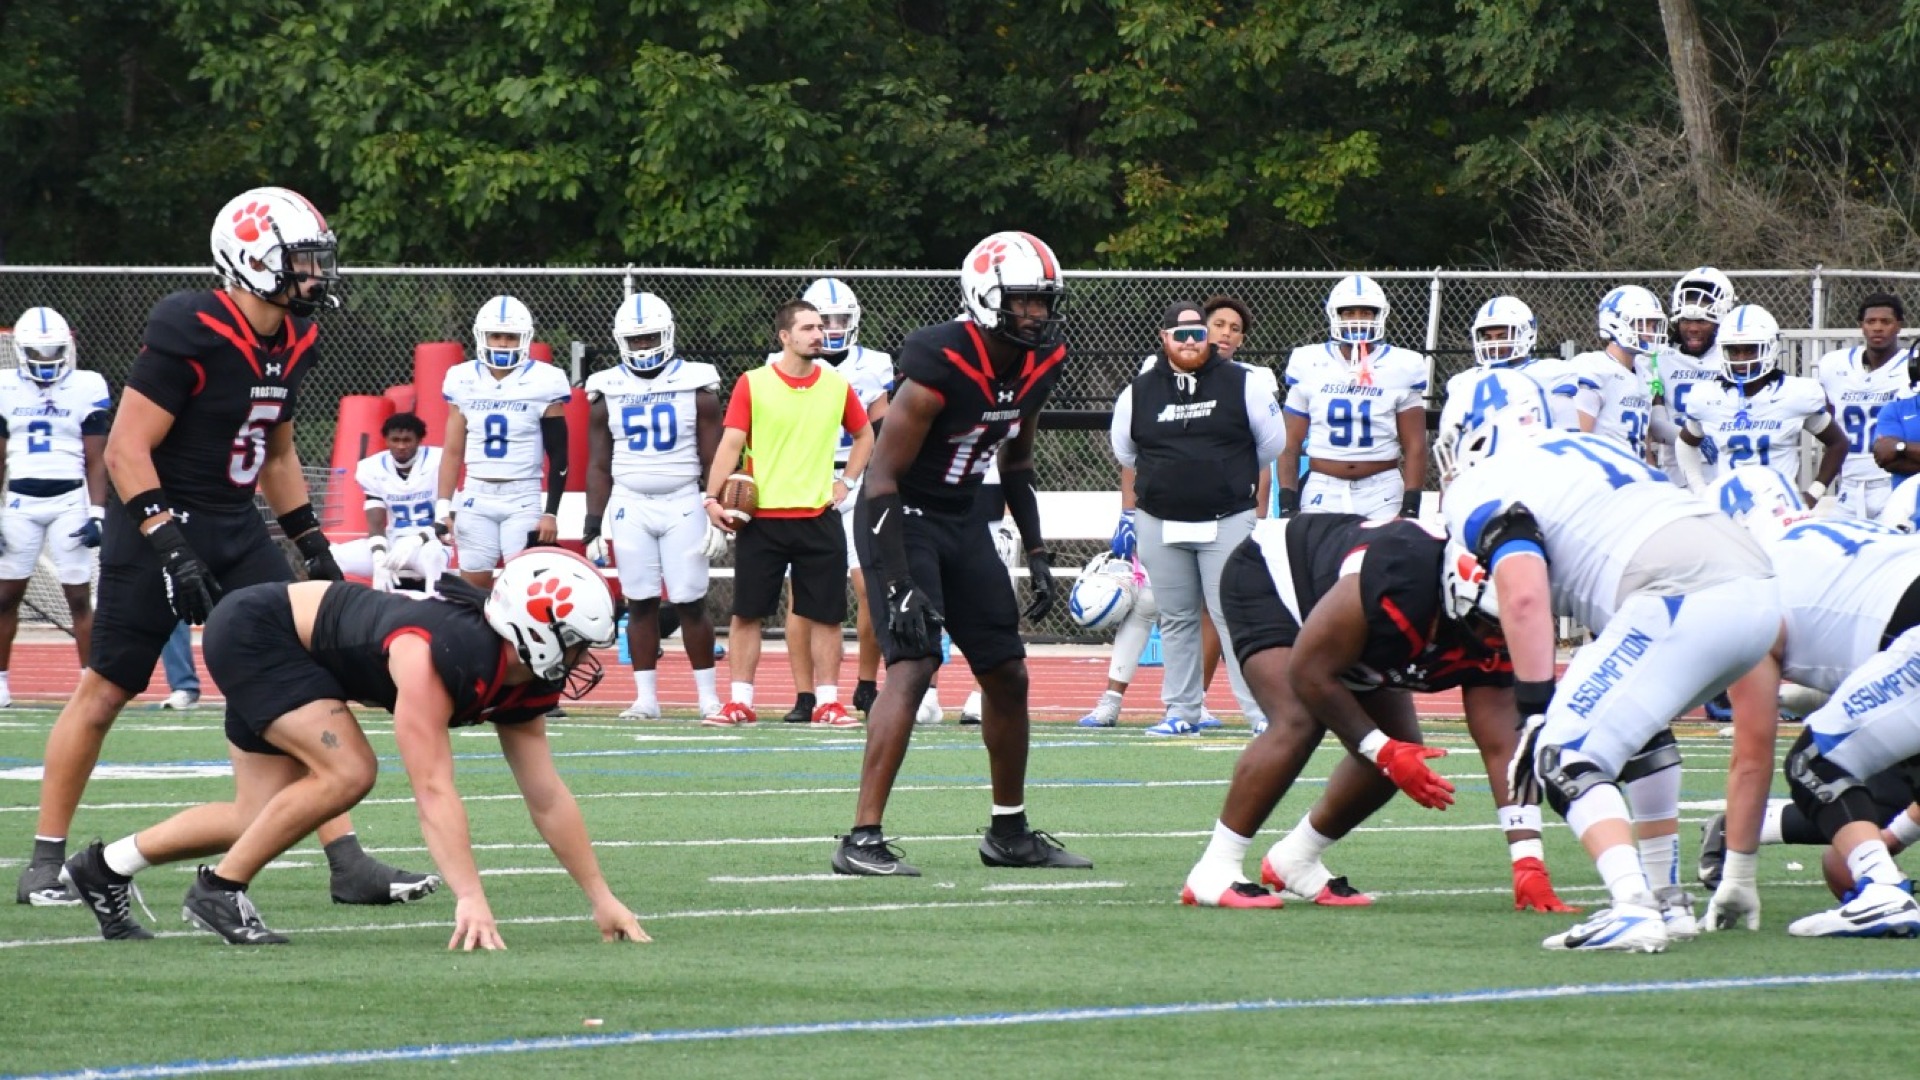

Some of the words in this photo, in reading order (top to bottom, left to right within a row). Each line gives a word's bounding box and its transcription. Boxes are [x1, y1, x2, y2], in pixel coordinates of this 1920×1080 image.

[470, 401, 530, 412] ASSUMPTION
[1320, 384, 1384, 397] ASSUMPTION
[28, 420, 52, 453] 2
[229, 402, 282, 486] 5
[484, 414, 508, 459] 8
[622, 402, 678, 452] 50
[1327, 399, 1374, 447] 91
[1566, 627, 1653, 719] ASSUMPTION
[1842, 650, 1920, 720] ASSUMPTIO
